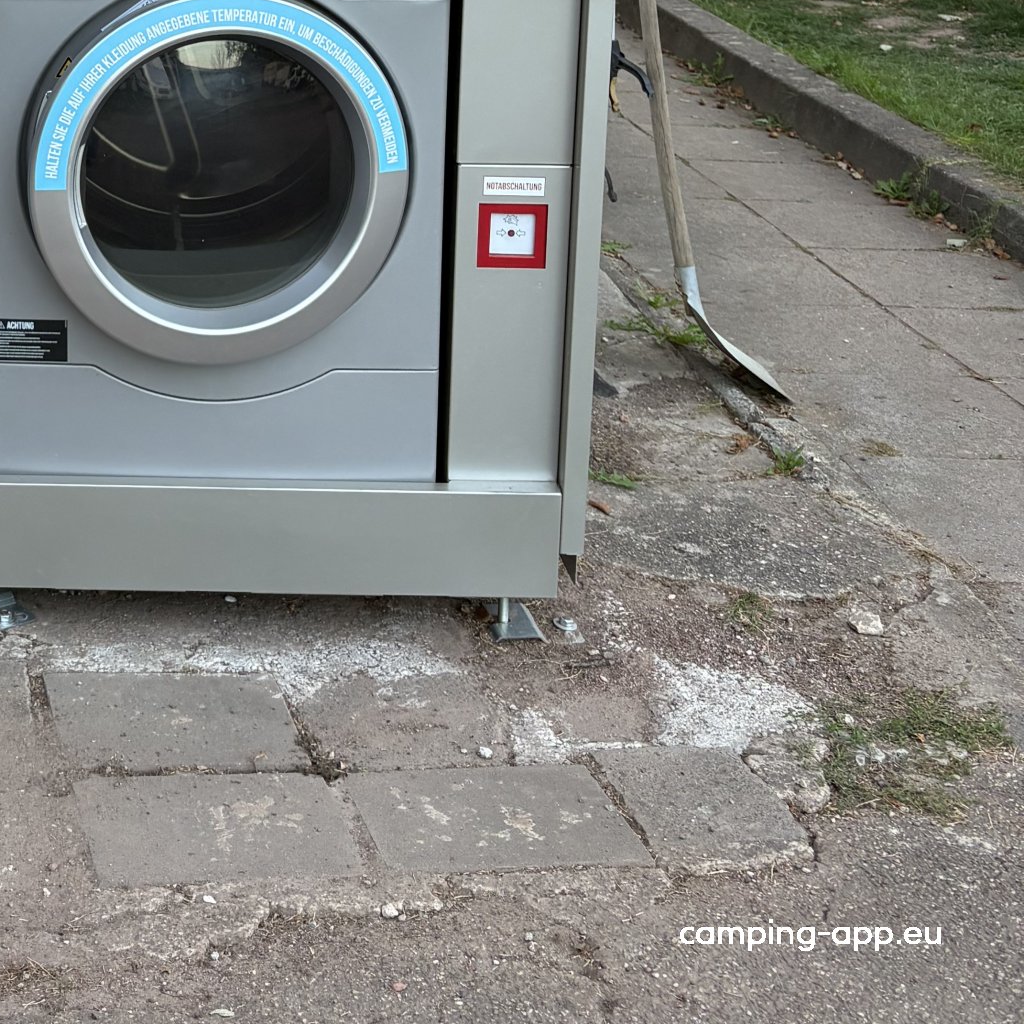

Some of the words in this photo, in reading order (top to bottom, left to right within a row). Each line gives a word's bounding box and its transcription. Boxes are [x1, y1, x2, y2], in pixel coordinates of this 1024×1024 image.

[146, 11, 210, 40] ANGEGEBENE
[211, 8, 277, 28] TEMPERATUR
[278, 16, 296, 35] EIN,
[297, 23, 314, 41] UM
[101, 31, 147, 69] KLEIDUNG
[312, 32, 378, 100] BESCHÄDIGUNGEN
[79, 64, 107, 93] IHRER
[67, 87, 85, 111] AUF
[370, 96, 384, 111] ZU
[59, 107, 76, 125] DIE
[52, 124, 68, 143] SIE
[376, 107, 399, 164] VERMEIDEN
[45, 142, 63, 180] HALTEN
[486, 182, 542, 191] NOTABSCHALTUNG
[7, 321, 34, 329] ACHTUNG
